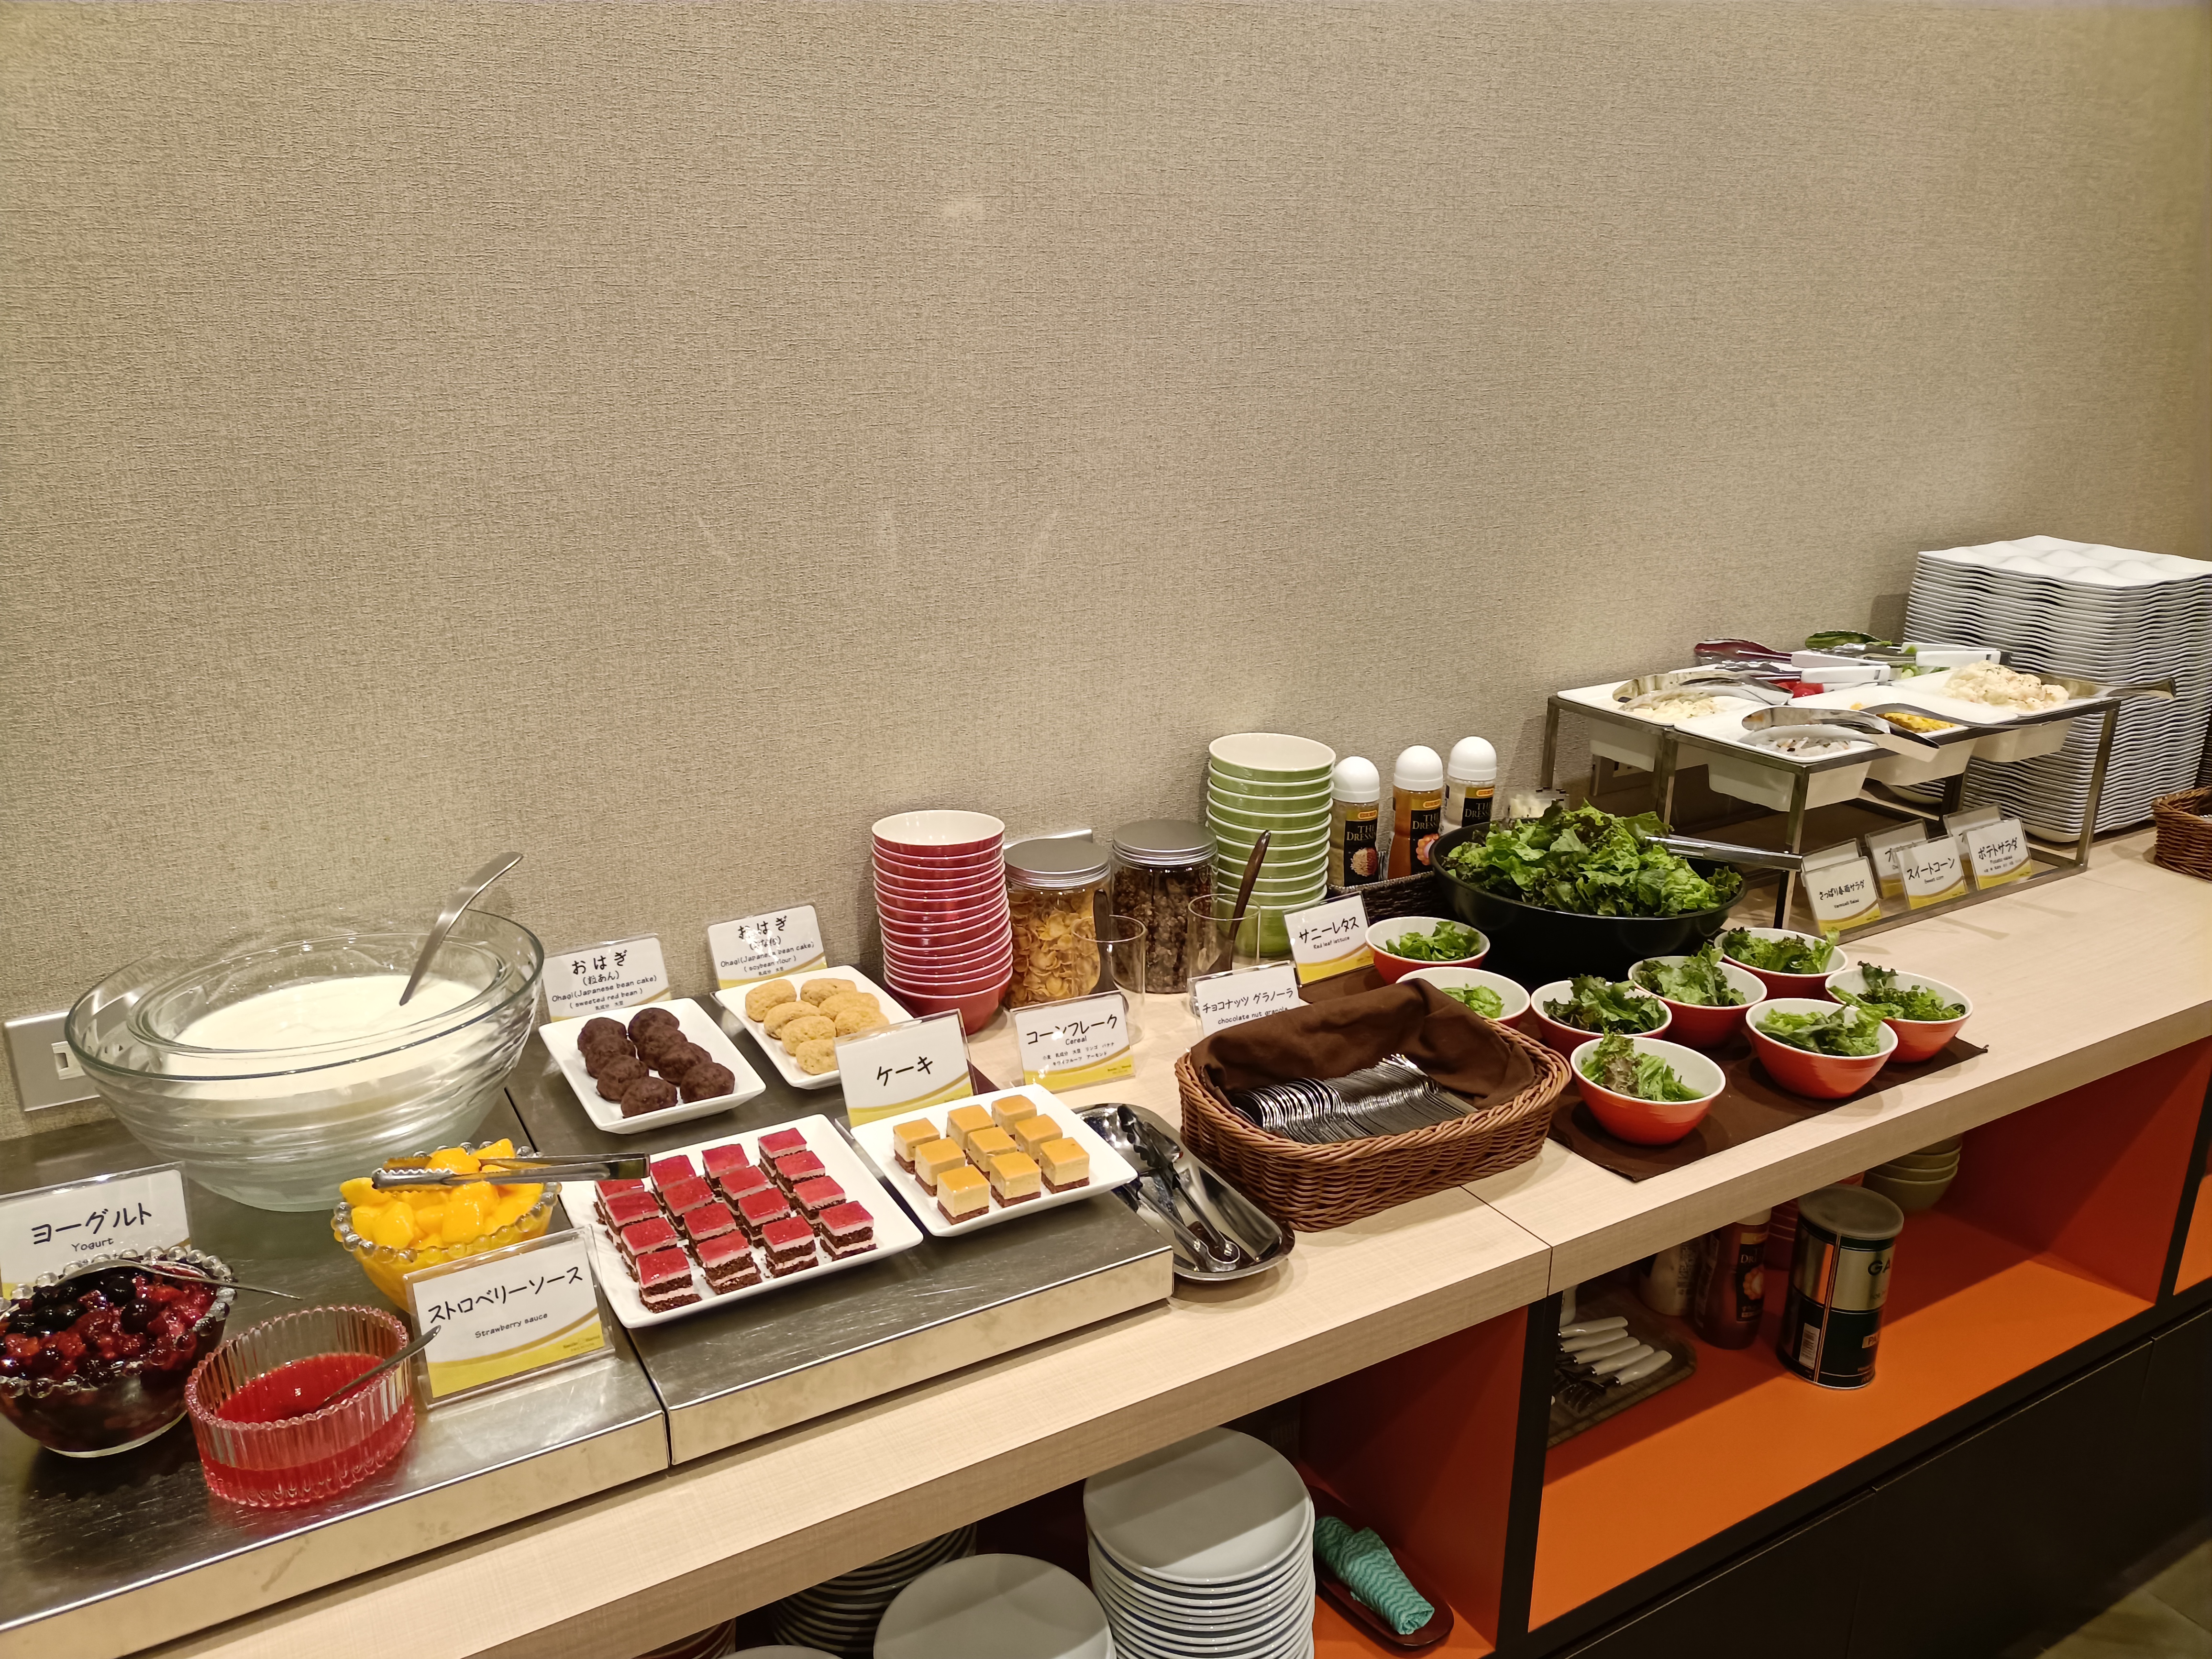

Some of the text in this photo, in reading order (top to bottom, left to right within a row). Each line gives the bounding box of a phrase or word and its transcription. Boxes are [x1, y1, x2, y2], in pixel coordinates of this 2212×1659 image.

[1978, 837, 2017, 860] ポテトサラダ
[1907, 858, 1955, 880] スイートコーン
[1299, 917, 1360, 944] サニーレタス
[572, 950, 628, 975] おはぎ
[617, 981, 634, 989] bean
[621, 989, 638, 997] bean
[1202, 987, 1294, 1014] チョコナッツ グラノーラ
[1027, 1014, 1117, 1045] コーンフレーク
[1218, 1014, 1250, 1025] chocolate
[1065, 1035, 1087, 1045] Cereal
[877, 1056, 933, 1086] ケーキ
[31, 1202, 152, 1245] ヨーグルト
[71, 1238, 114, 1252] Yogurt
[428, 1267, 583, 1324] ストロベリーソース
[475, 1313, 548, 1338] Strawberry sauce
